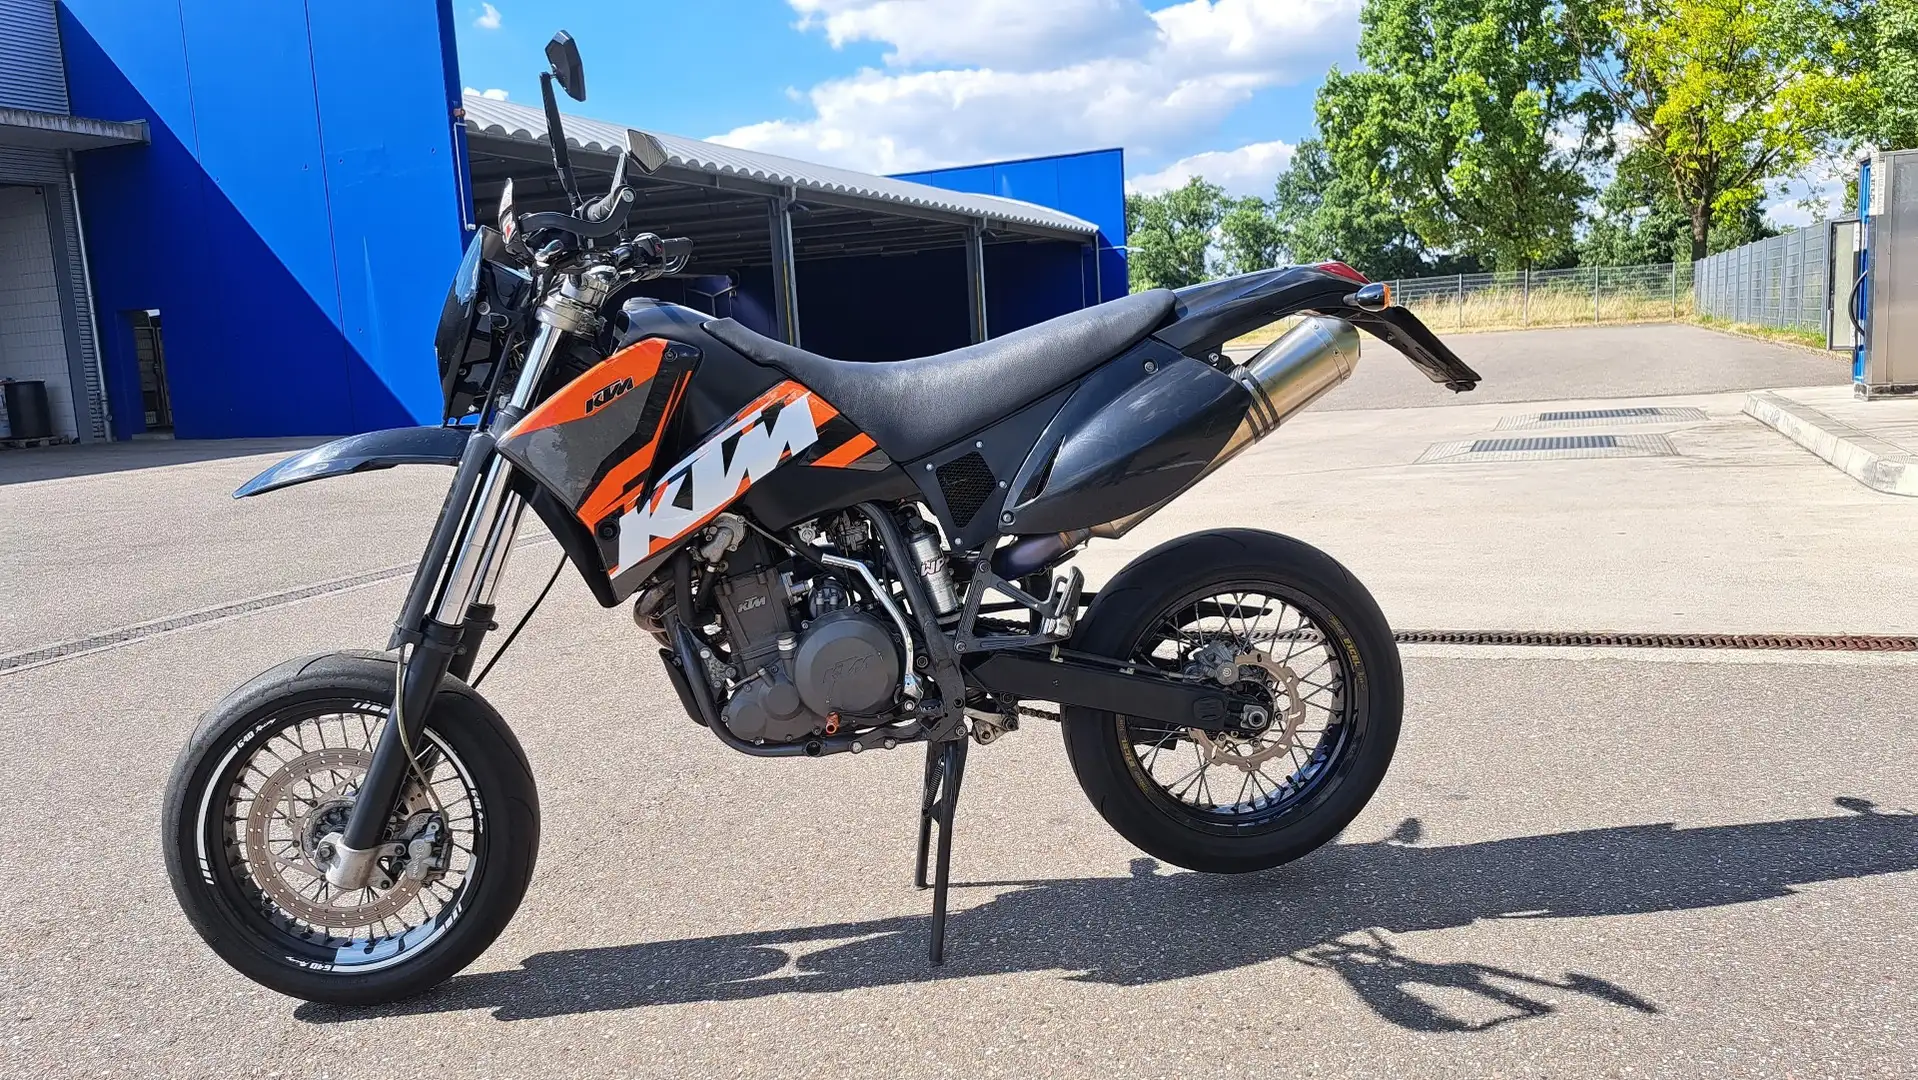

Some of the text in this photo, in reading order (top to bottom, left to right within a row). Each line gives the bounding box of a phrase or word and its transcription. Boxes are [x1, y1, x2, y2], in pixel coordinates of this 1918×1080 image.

[585, 376, 635, 416] KTM
[609, 391, 819, 580] KTM
[920, 557, 946, 577] WP
[737, 595, 766, 613] KTM
[237, 730, 255, 748] 640
[470, 789, 482, 809] 640
[309, 962, 332, 971] 640
